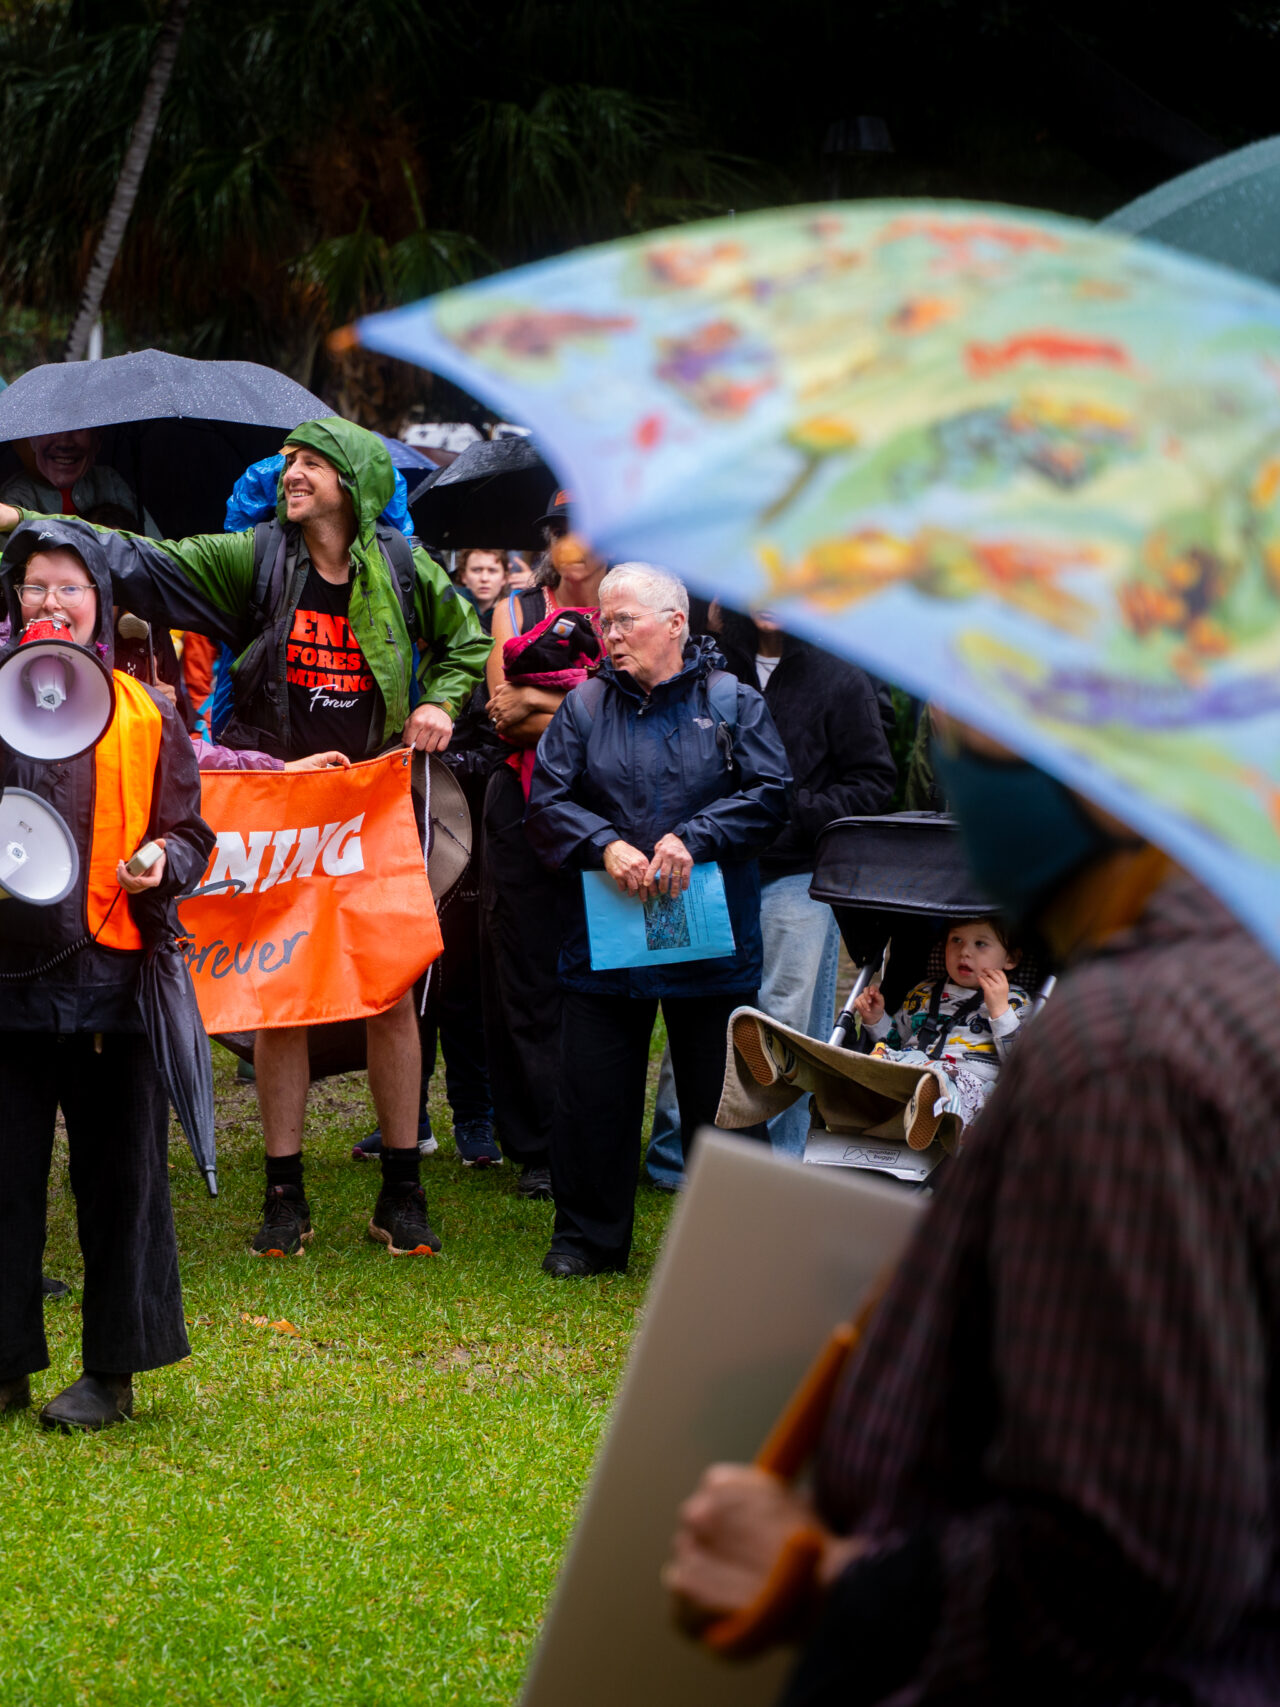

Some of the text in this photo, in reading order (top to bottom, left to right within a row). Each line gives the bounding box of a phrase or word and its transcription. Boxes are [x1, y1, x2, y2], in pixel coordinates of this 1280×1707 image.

[286, 666, 374, 693] MINING
[309, 684, 359, 712] Forever
[194, 812, 366, 896] NING
[183, 931, 309, 978] orever
